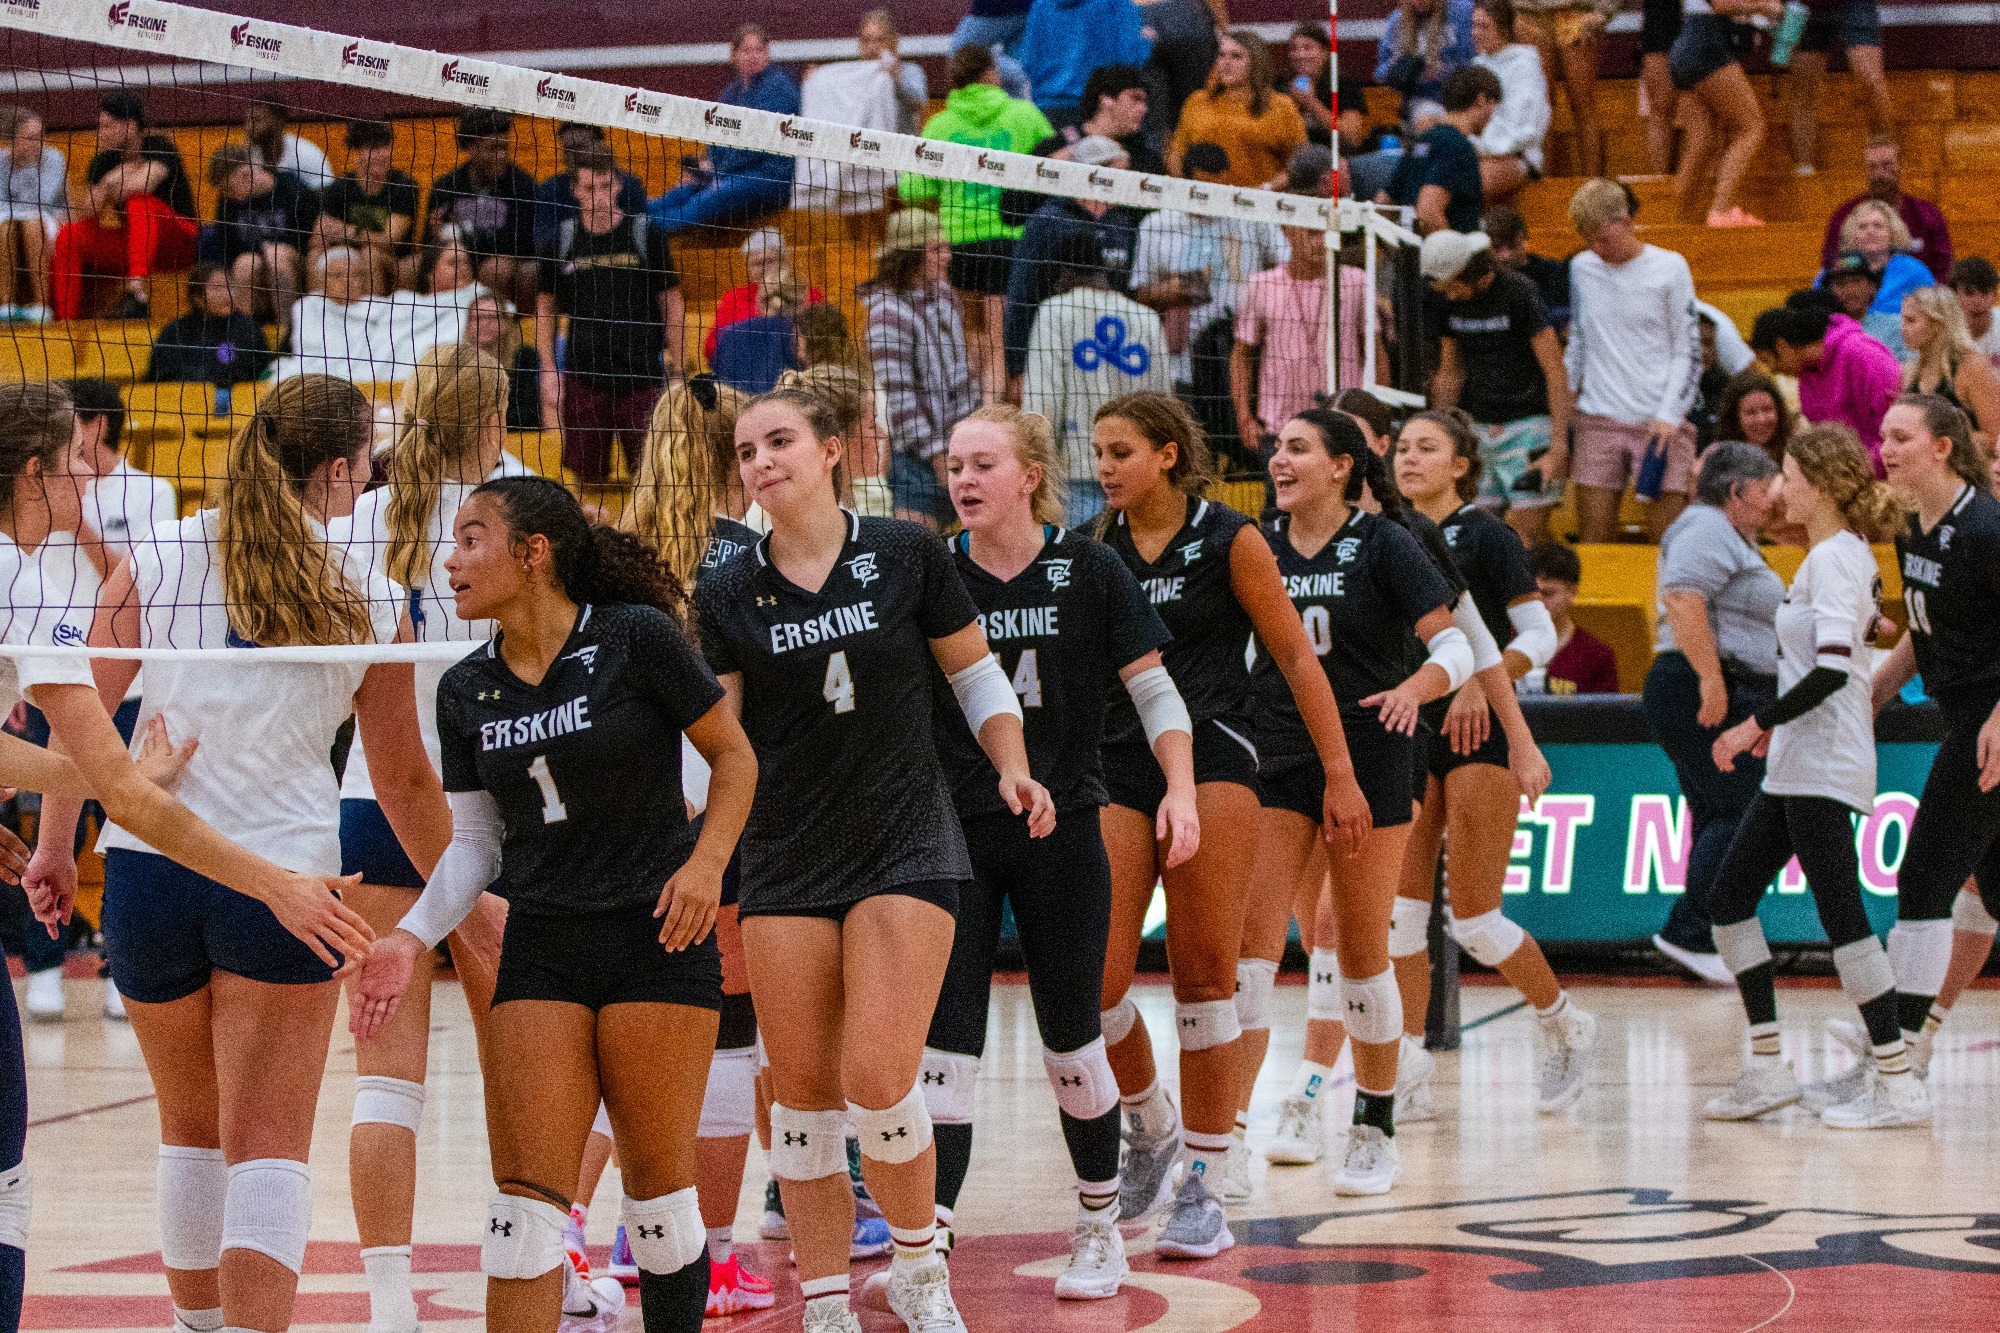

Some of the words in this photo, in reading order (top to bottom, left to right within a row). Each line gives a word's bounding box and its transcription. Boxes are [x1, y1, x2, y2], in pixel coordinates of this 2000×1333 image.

[768, 600, 879, 654] ERSKINE
[822, 649, 856, 715] 4
[481, 695, 592, 751] ERSKINE
[527, 754, 568, 825] 1
